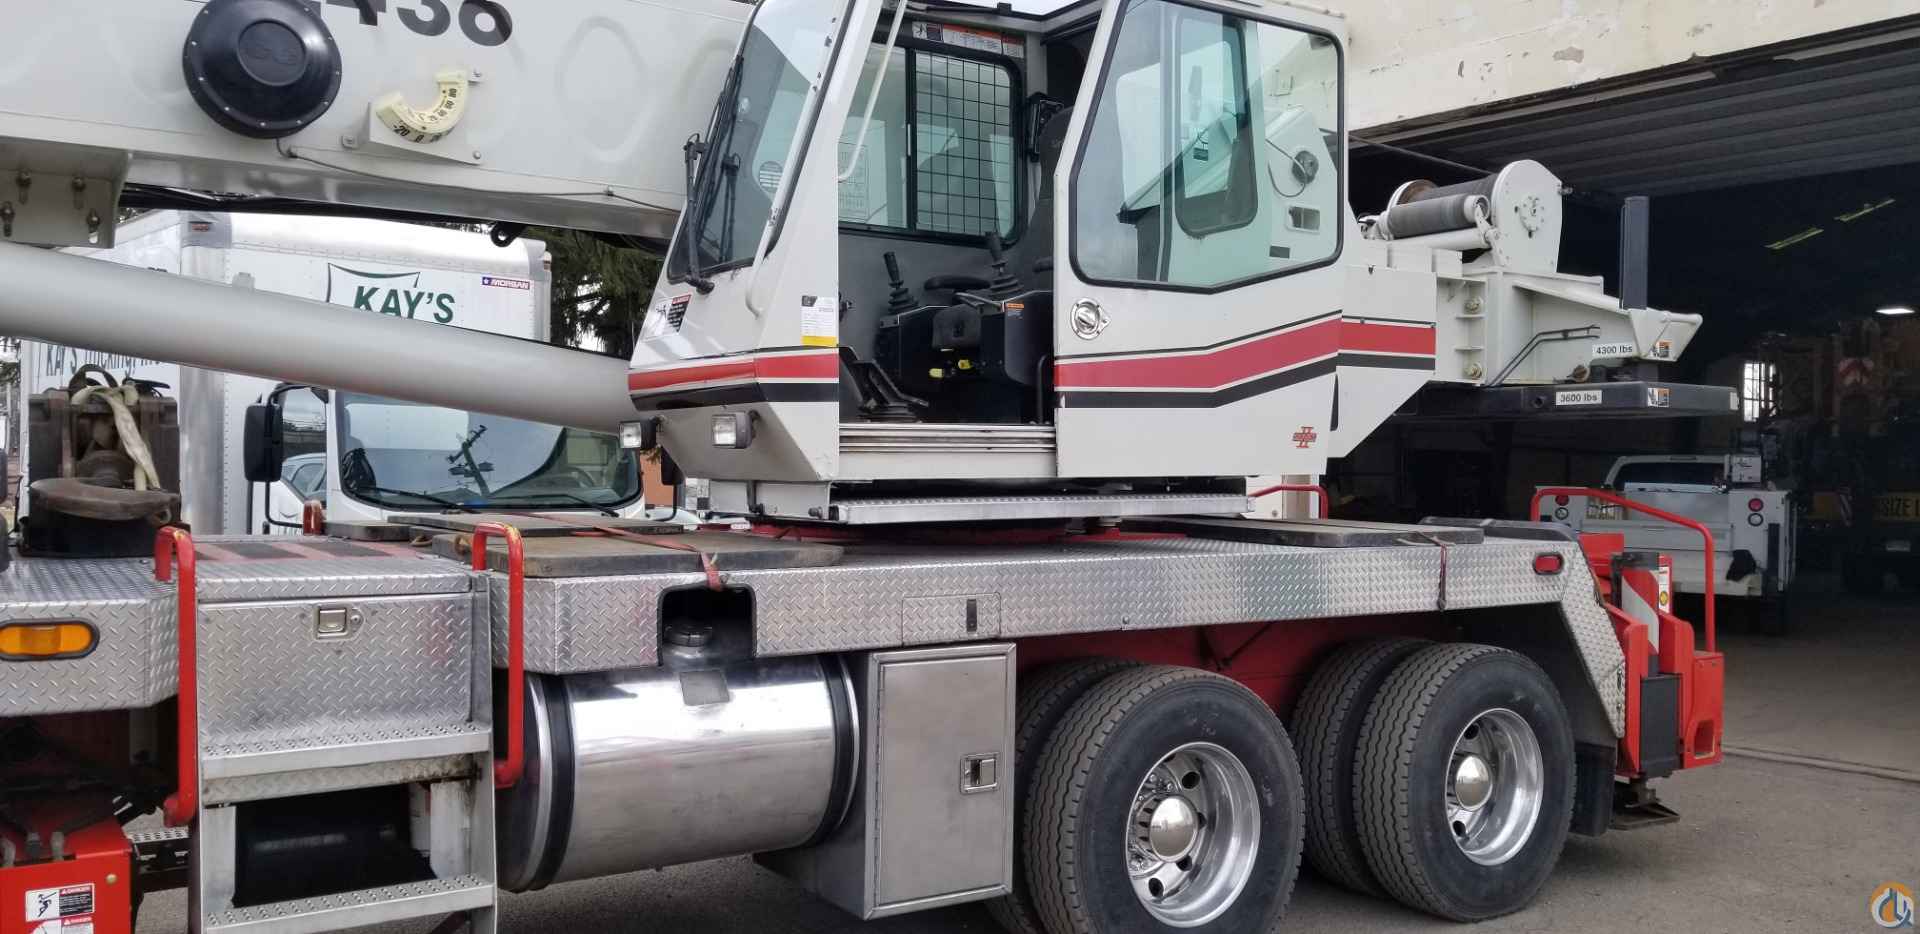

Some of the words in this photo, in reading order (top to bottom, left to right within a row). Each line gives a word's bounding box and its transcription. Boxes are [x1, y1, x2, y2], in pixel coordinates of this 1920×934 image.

[354, 286, 455, 323] KAY'S
[1596, 346, 1617, 354] 4300
[1619, 345, 1633, 353] lbs
[1583, 392, 1597, 401] lbs
